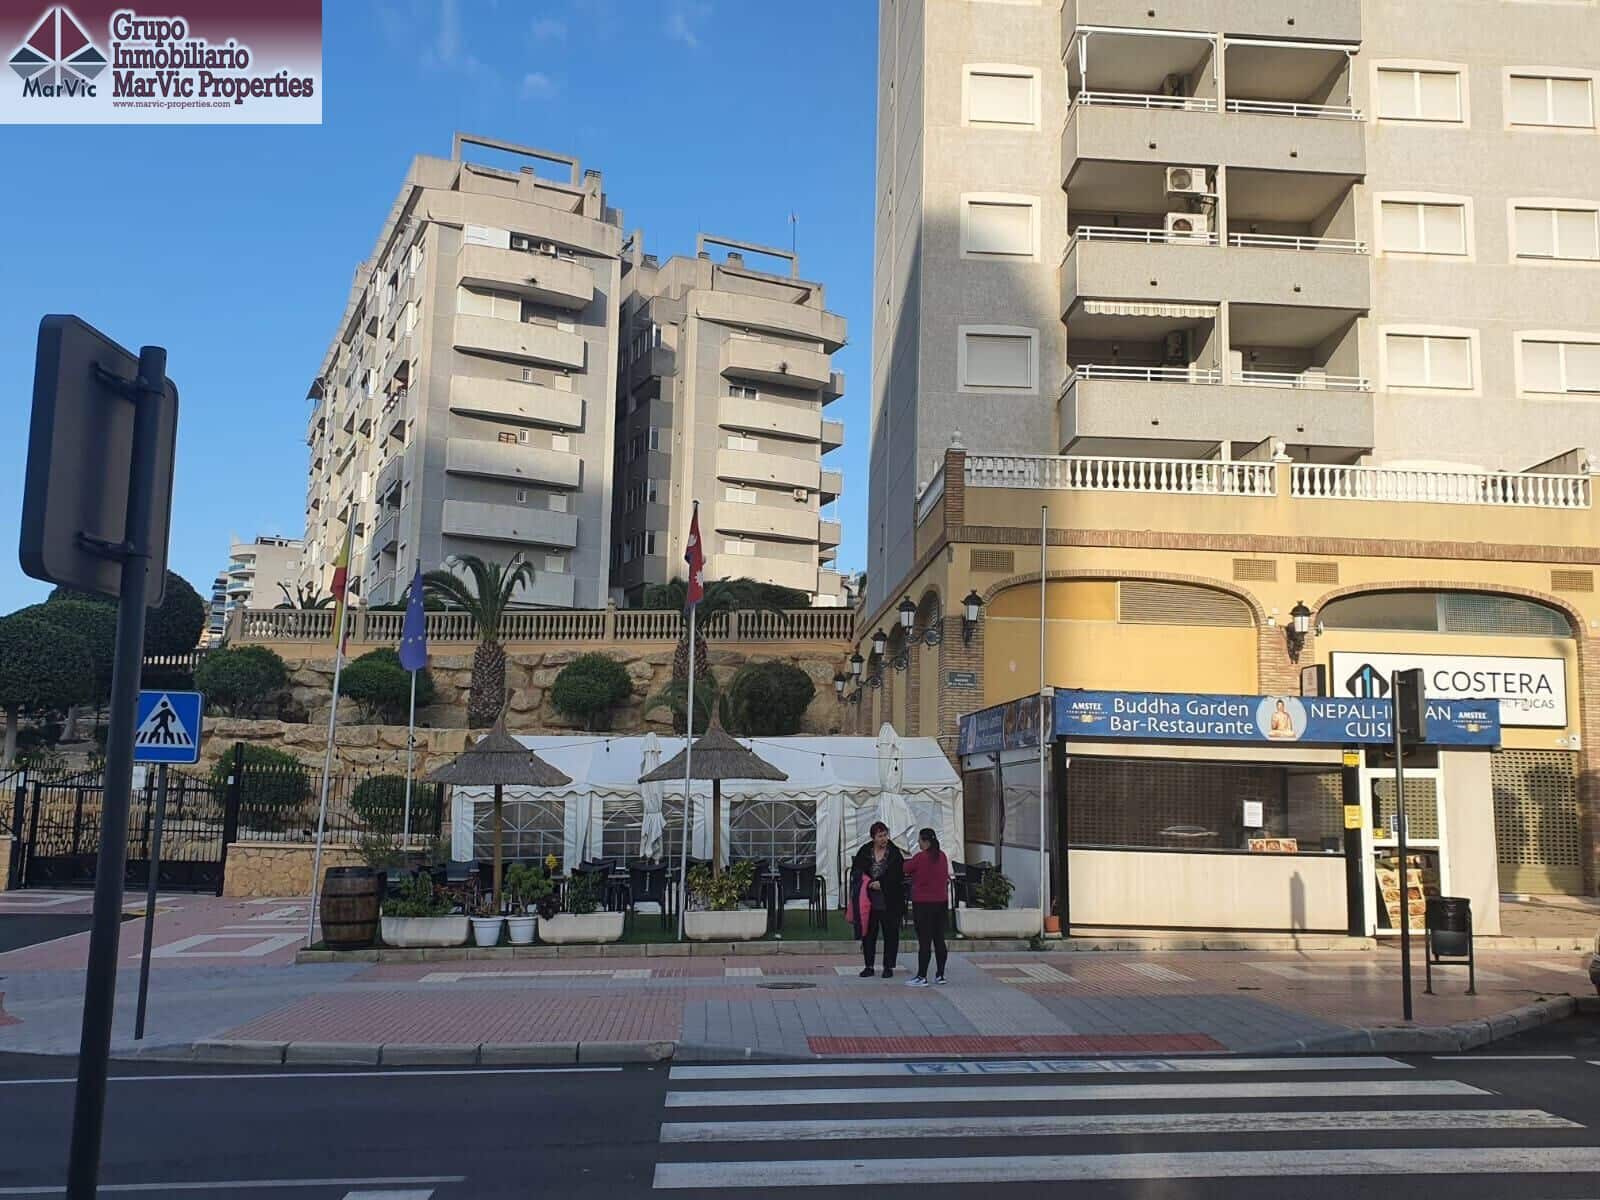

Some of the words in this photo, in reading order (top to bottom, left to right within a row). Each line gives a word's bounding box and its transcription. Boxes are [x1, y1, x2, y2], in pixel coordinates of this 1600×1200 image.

[1433, 670, 1552, 694] COSTERA
[1114, 697, 1180, 714] Buddha
[1186, 699, 1249, 717] Garden
[1110, 716, 1254, 735] Bar-Restaurante
